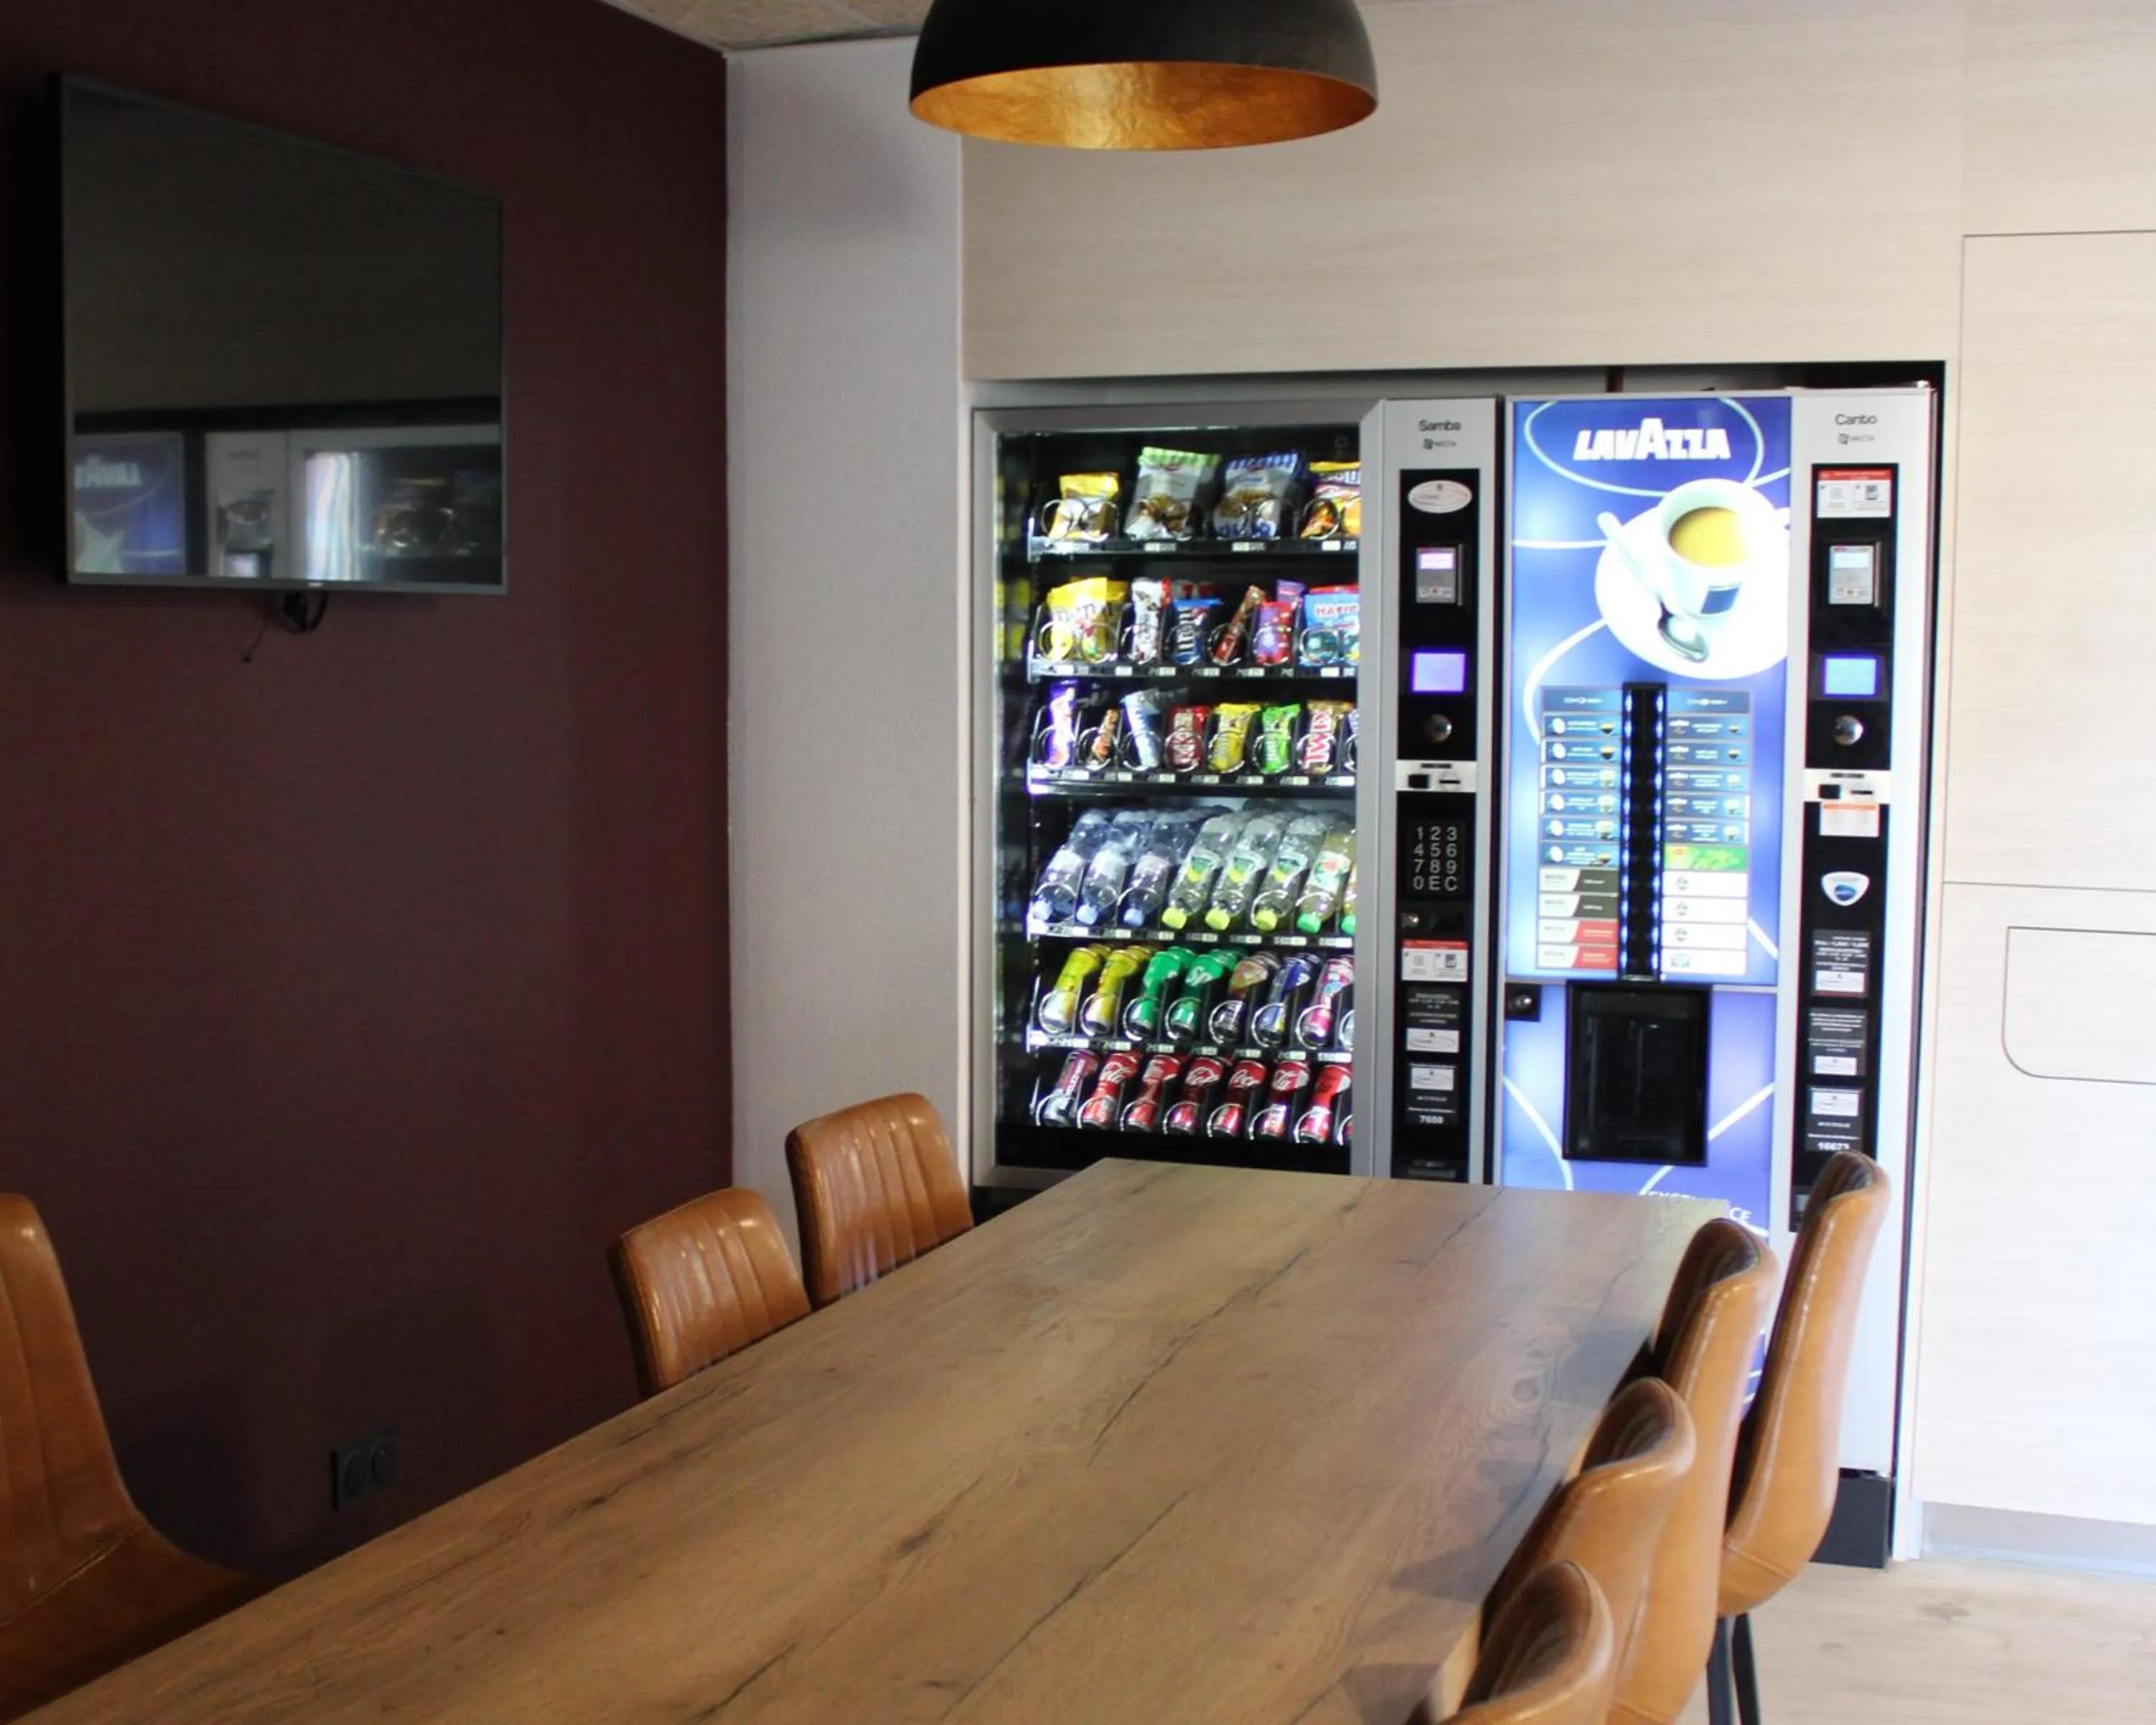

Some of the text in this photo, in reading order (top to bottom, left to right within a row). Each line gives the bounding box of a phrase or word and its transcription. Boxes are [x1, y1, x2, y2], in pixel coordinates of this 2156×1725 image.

[1573, 418, 1731, 460] LAVAZZA
[1416, 826, 1457, 841] 1 2 3
[1413, 843, 1457, 857] 4 5 6
[1414, 859, 1457, 874] 7 8 9
[1429, 875, 1441, 891] E
[1445, 876, 1457, 891] C
